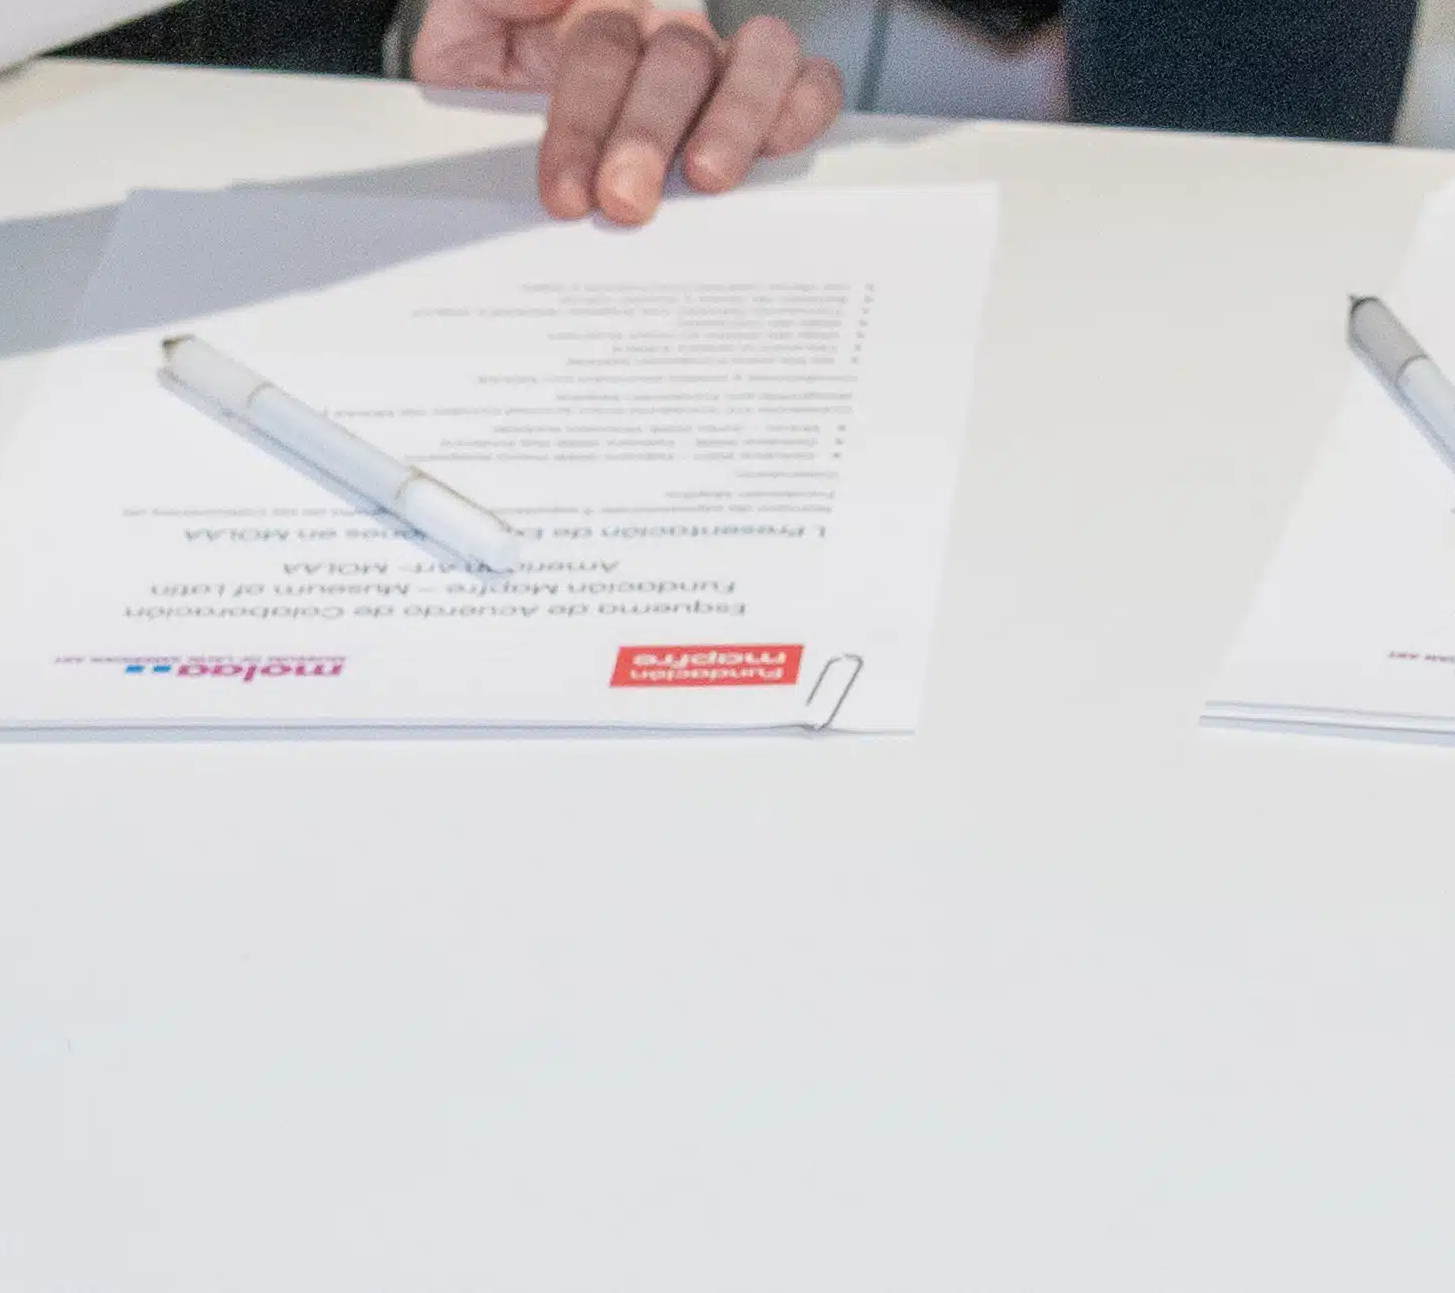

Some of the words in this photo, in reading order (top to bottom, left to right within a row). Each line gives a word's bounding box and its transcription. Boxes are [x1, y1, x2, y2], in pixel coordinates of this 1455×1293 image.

[183, 528, 290, 542] MOLAA
[298, 530, 337, 541] en
[552, 527, 592, 539] de
[601, 525, 805, 539] Presentación
[282, 562, 388, 575] MOLAA
[150, 584, 226, 598] Latin
[236, 584, 265, 597] of
[275, 583, 411, 596] Museum
[445, 579, 559, 597] Mapfre
[568, 581, 737, 596] Fundación
[124, 606, 345, 622] Colaboración
[354, 606, 394, 619] de
[404, 604, 540, 619] Acuerdo
[548, 604, 588, 618] de
[598, 599, 748, 617] Esquema
[631, 651, 787, 667] mapfre
[176, 663, 344, 684] molaa
[629, 667, 784, 682] Fundación
